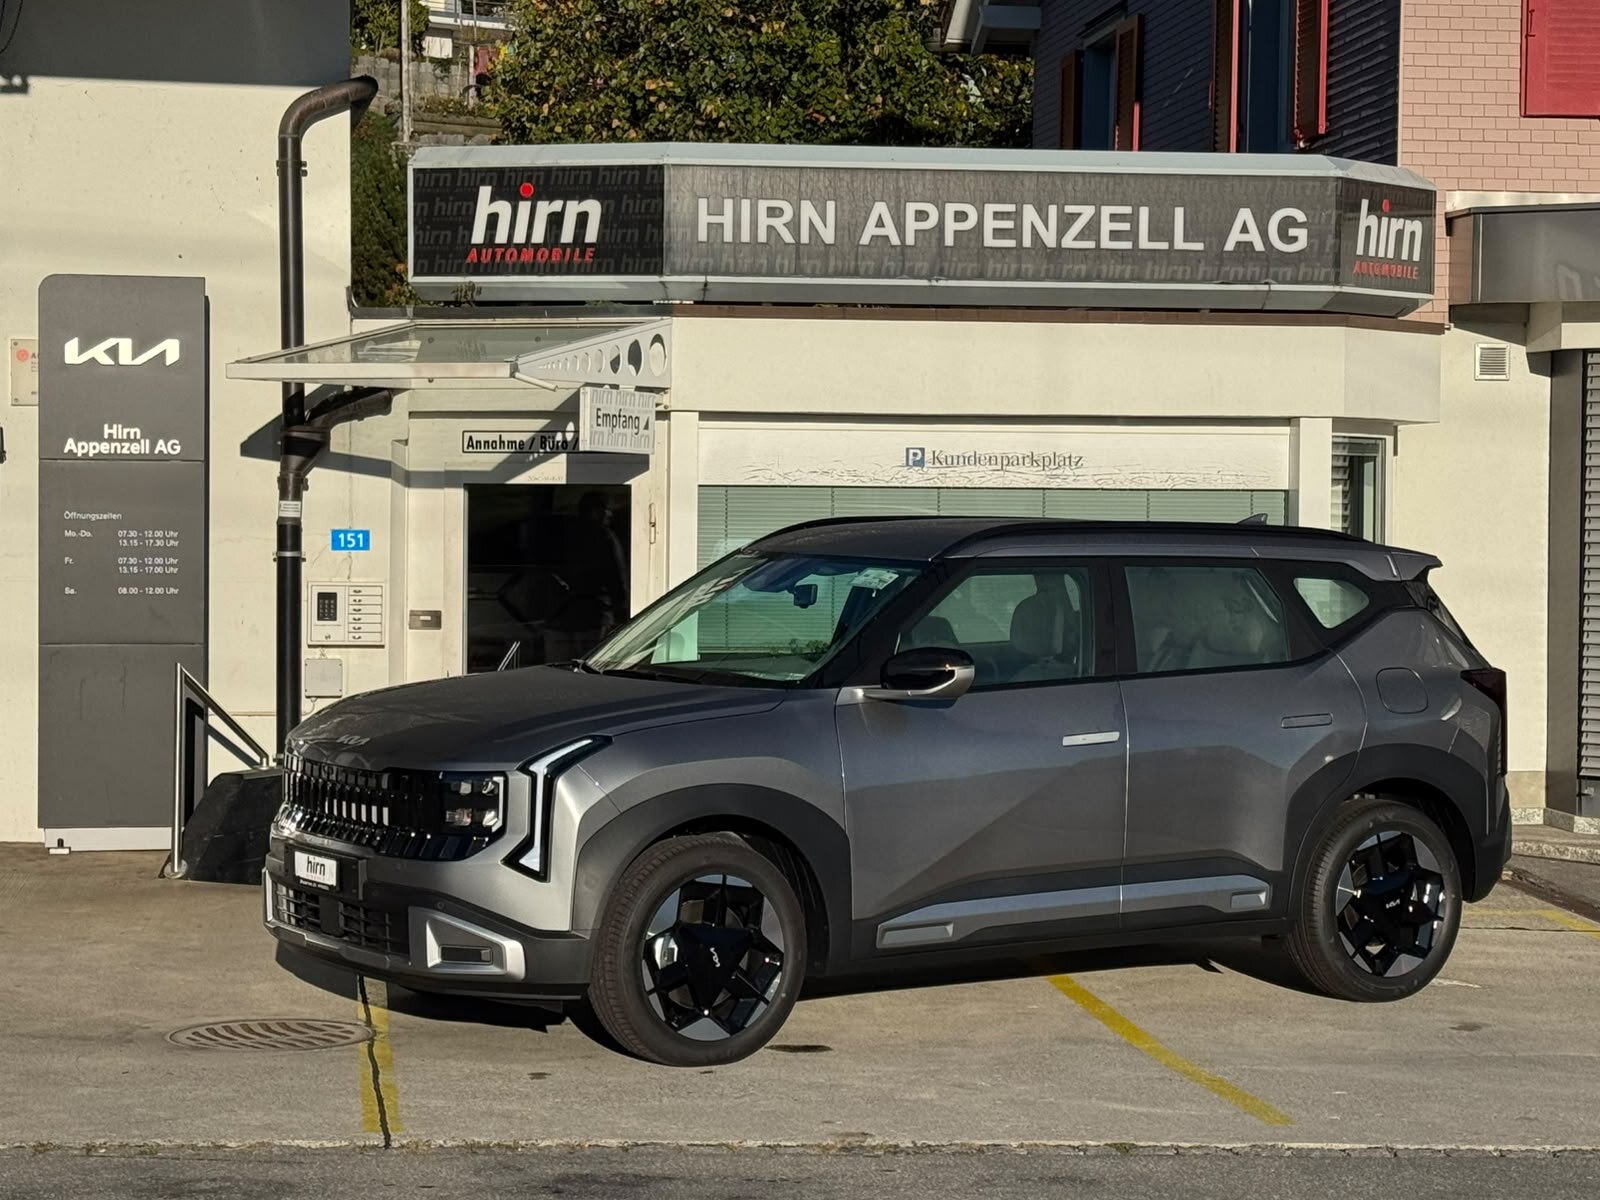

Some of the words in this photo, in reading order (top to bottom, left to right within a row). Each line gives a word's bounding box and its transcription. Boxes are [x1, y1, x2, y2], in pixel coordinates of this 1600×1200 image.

[470, 182, 601, 244] hirn
[697, 197, 836, 246] HIRN
[858, 200, 1205, 252] APPENZELL
[1222, 207, 1309, 254] AG
[1355, 198, 1423, 262] hirn
[465, 247, 596, 265] AUTOMOBILE
[1353, 260, 1420, 280] AUTOMOBILE
[64, 337, 180, 366] KIA
[596, 407, 640, 436] Empfang
[103, 423, 141, 440] Hirn
[63, 437, 150, 457] Appenzell
[154, 438, 181, 455] AG
[466, 434, 525, 450] Annahme
[528, 437, 535, 451] /
[539, 436, 569, 450] Büro
[909, 449, 922, 466] P
[931, 450, 1084, 471] Kundenparkplatz
[63, 510, 122, 521] Öffnungszeiten
[117, 530, 138, 538] 07.30
[144, 530, 163, 538] 12.00
[164, 530, 179, 538] Uhr
[119, 539, 138, 547] 13.15
[145, 539, 164, 547] 17.30
[165, 539, 179, 547] Uhr
[338, 533, 364, 548] 151
[64, 556, 74, 565] Fr.
[117, 557, 138, 565] 07.30
[144, 557, 163, 565] 12.00
[164, 557, 179, 565] Uhr
[119, 566, 138, 574] 13.15
[145, 566, 164, 574] 17.00
[164, 566, 179, 574] Uhr
[64, 587, 77, 595] Sa.
[117, 587, 138, 595] 08.00
[145, 587, 164, 595] 12.00
[165, 587, 179, 595] Uhr
[306, 855, 326, 877] hirn
